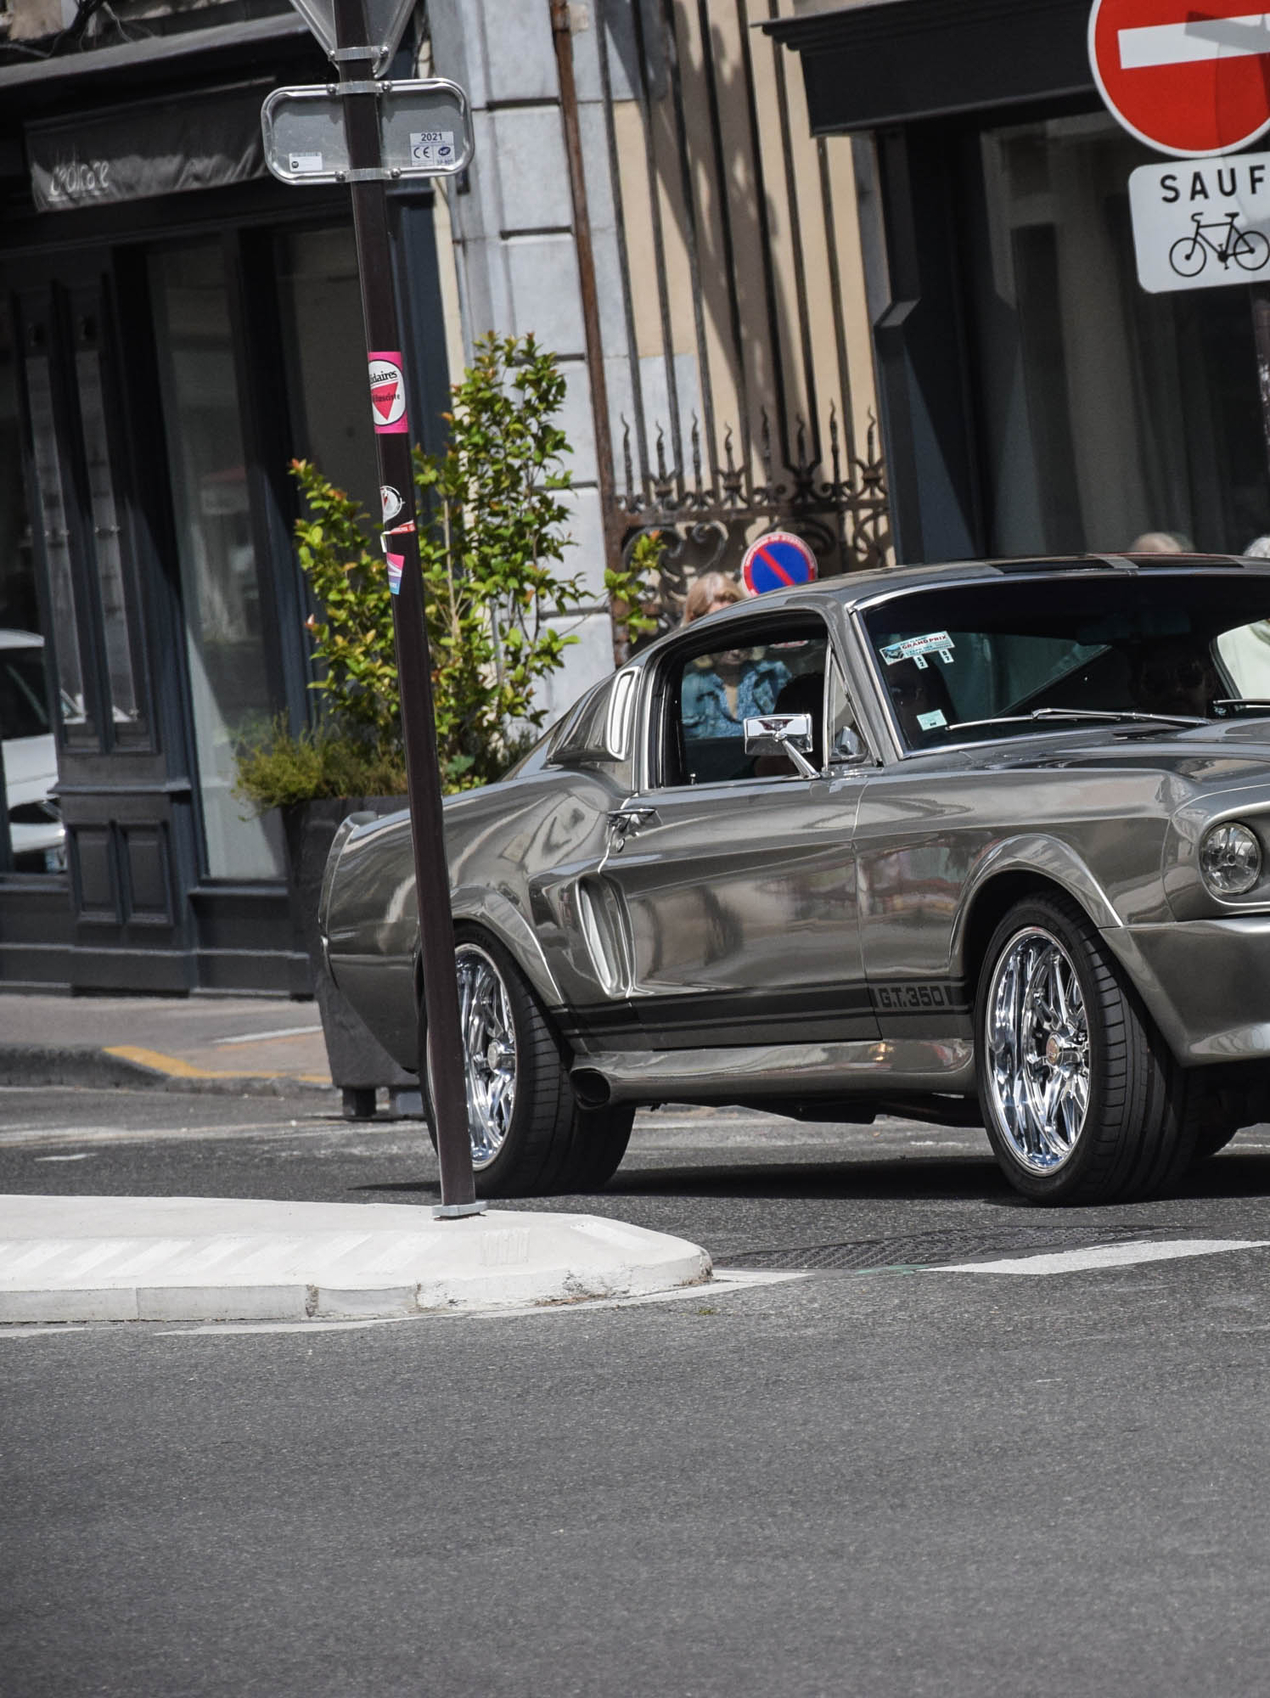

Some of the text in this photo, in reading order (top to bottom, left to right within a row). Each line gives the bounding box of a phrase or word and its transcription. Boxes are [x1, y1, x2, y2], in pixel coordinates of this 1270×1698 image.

[420, 132, 443, 142] 2021
[1159, 164, 1266, 204] SAUF
[901, 639, 929, 650] GRAND
[928, 634, 947, 644] PRIX
